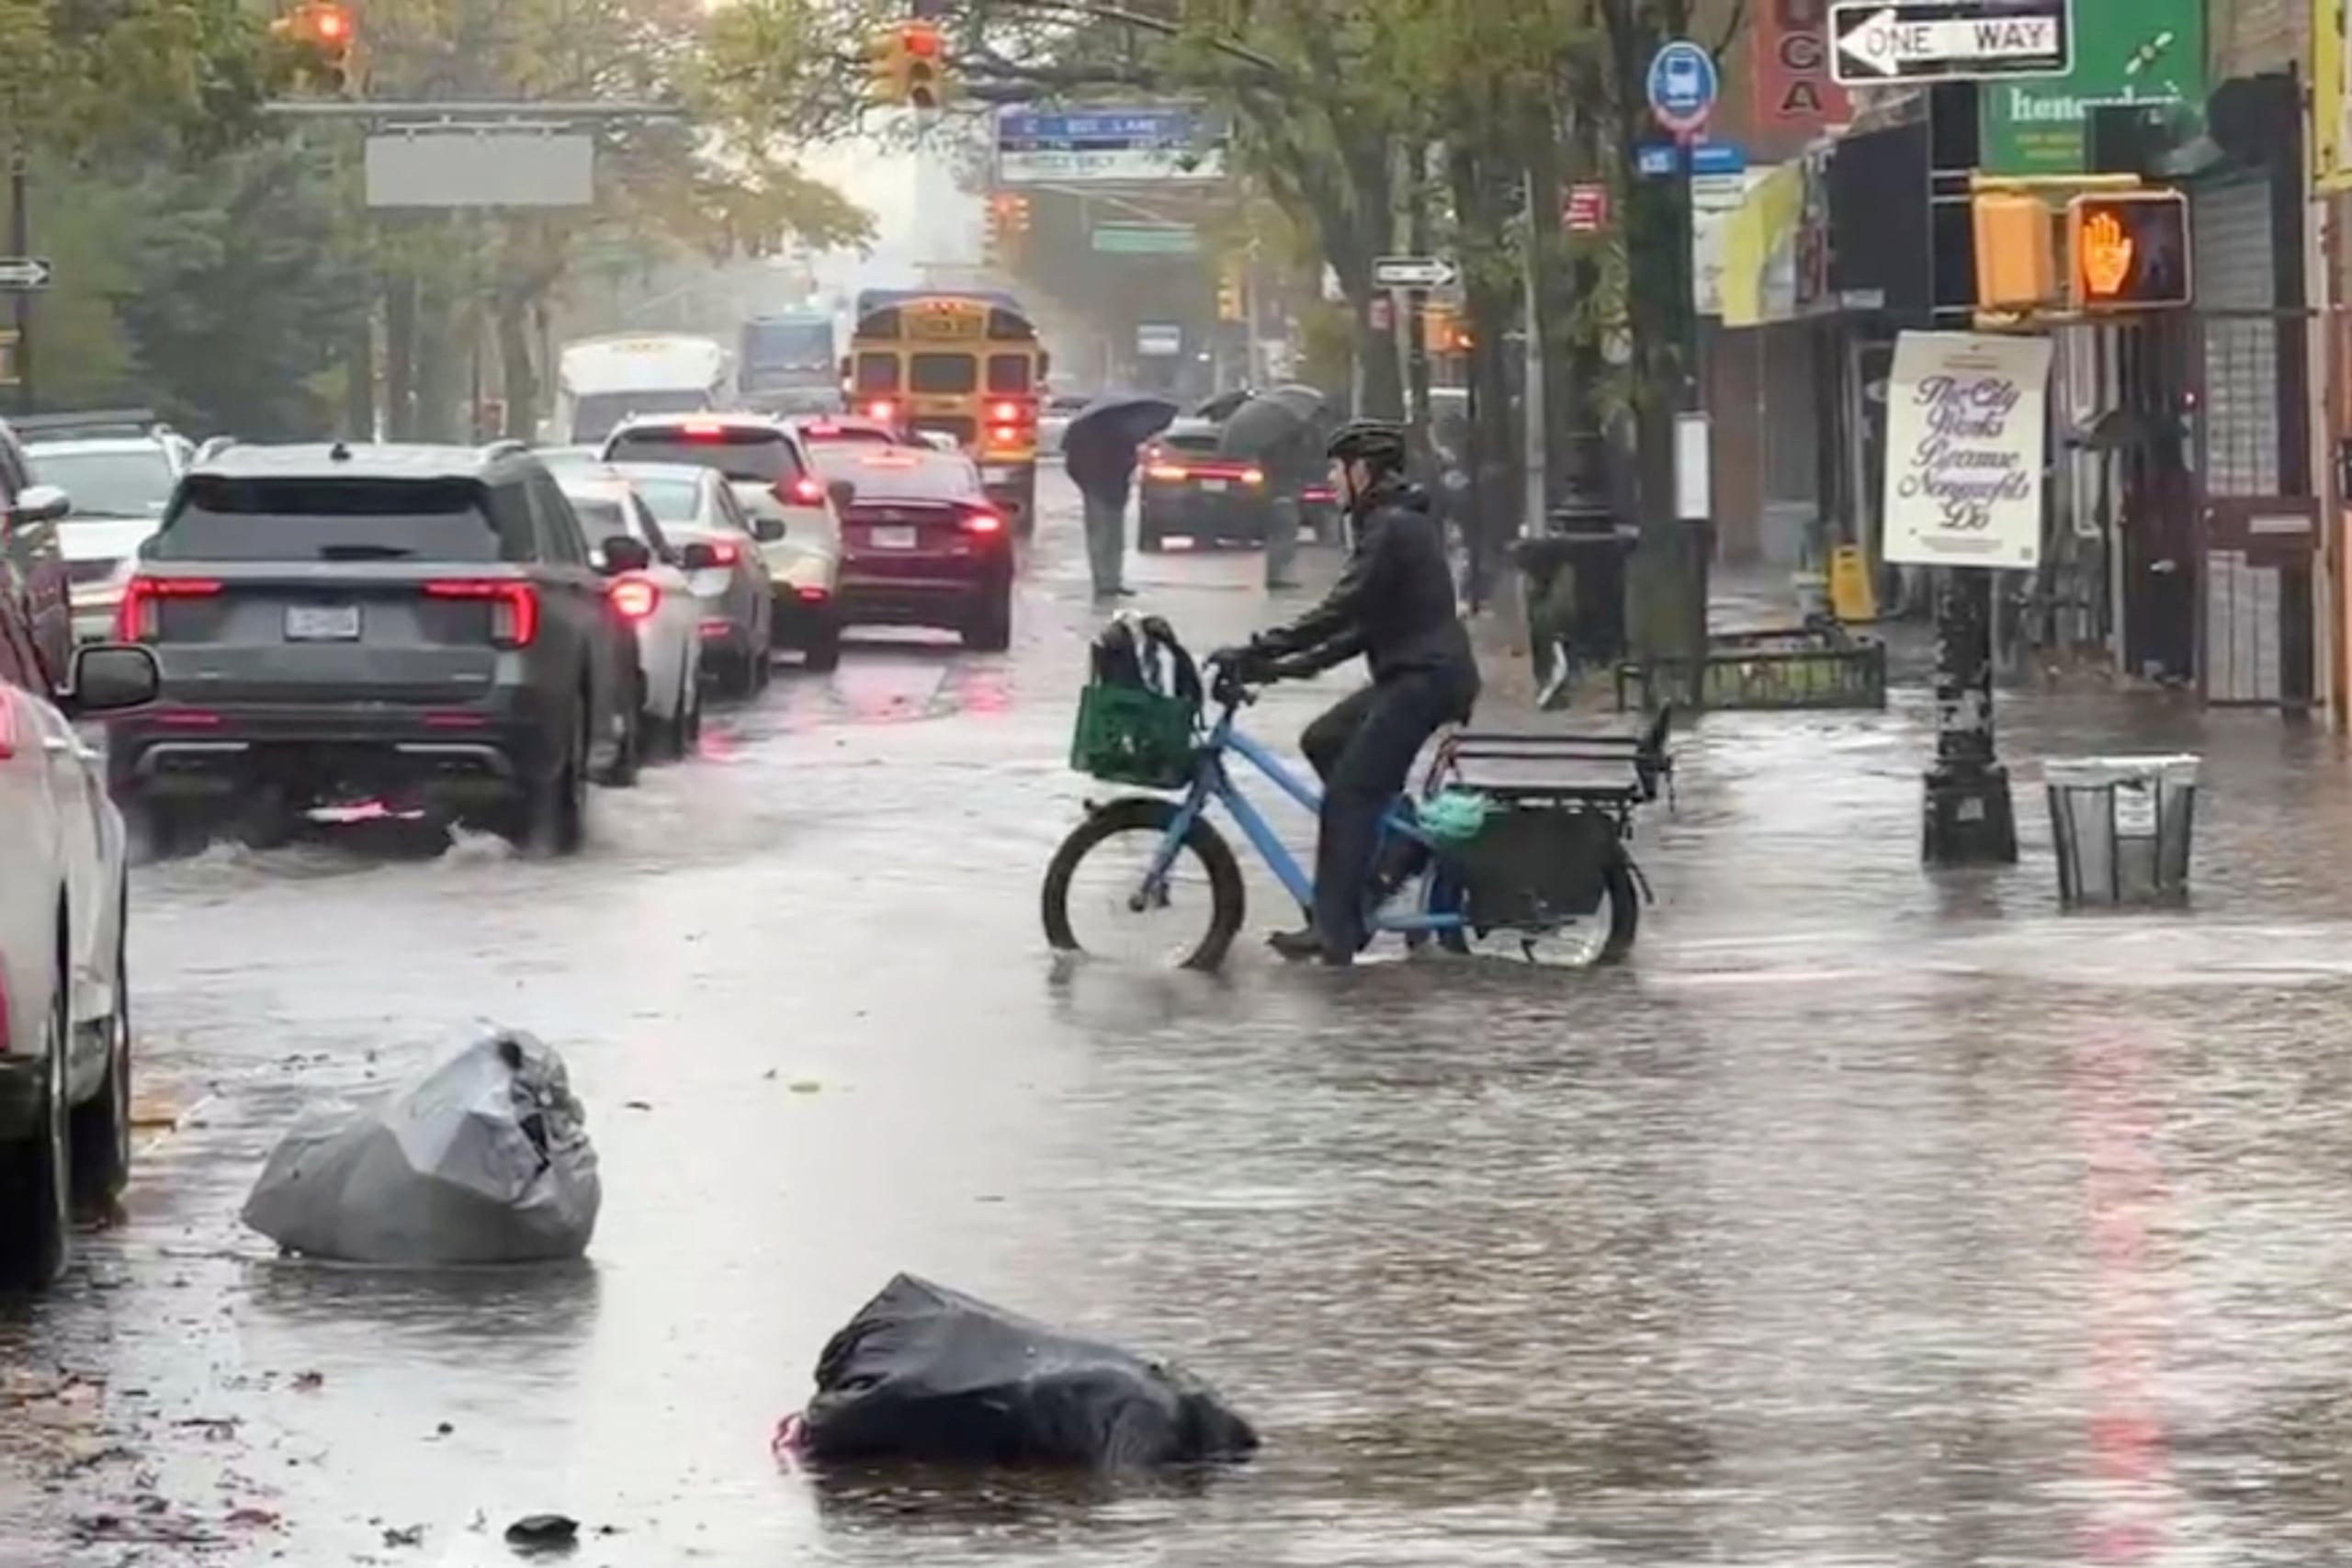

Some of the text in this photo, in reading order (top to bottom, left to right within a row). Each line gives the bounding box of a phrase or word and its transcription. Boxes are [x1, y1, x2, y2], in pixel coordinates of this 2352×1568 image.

[1866, 23, 2047, 56] ONE WAY
[1971, 377, 2021, 413] City
[1938, 501, 1990, 530] Do
